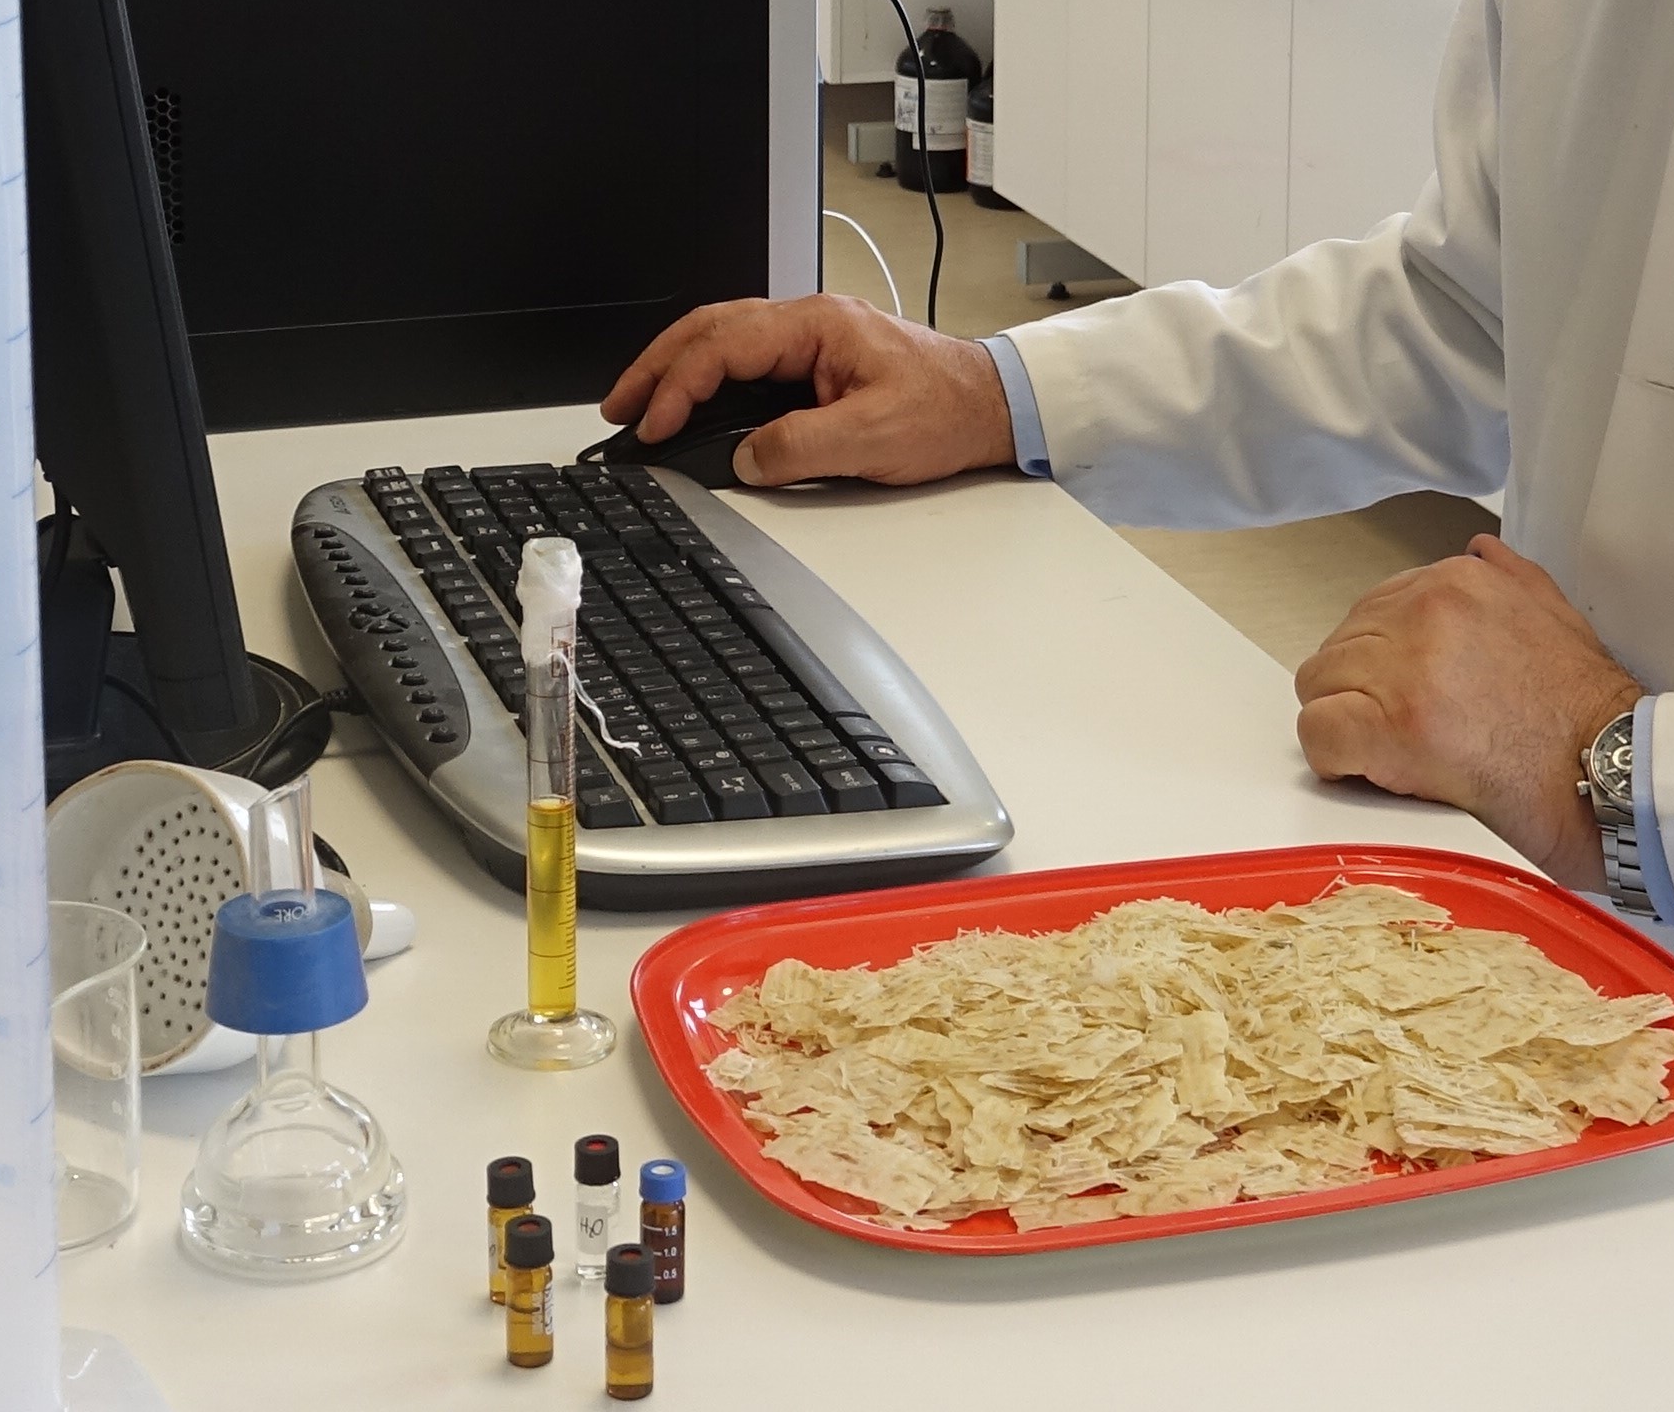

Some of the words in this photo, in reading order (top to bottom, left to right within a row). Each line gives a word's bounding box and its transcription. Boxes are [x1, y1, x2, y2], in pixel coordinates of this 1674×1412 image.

[664, 1224, 677, 1236] 1.5
[664, 1246, 677, 1257] 1.0
[663, 1268, 677, 1279] 0.5
